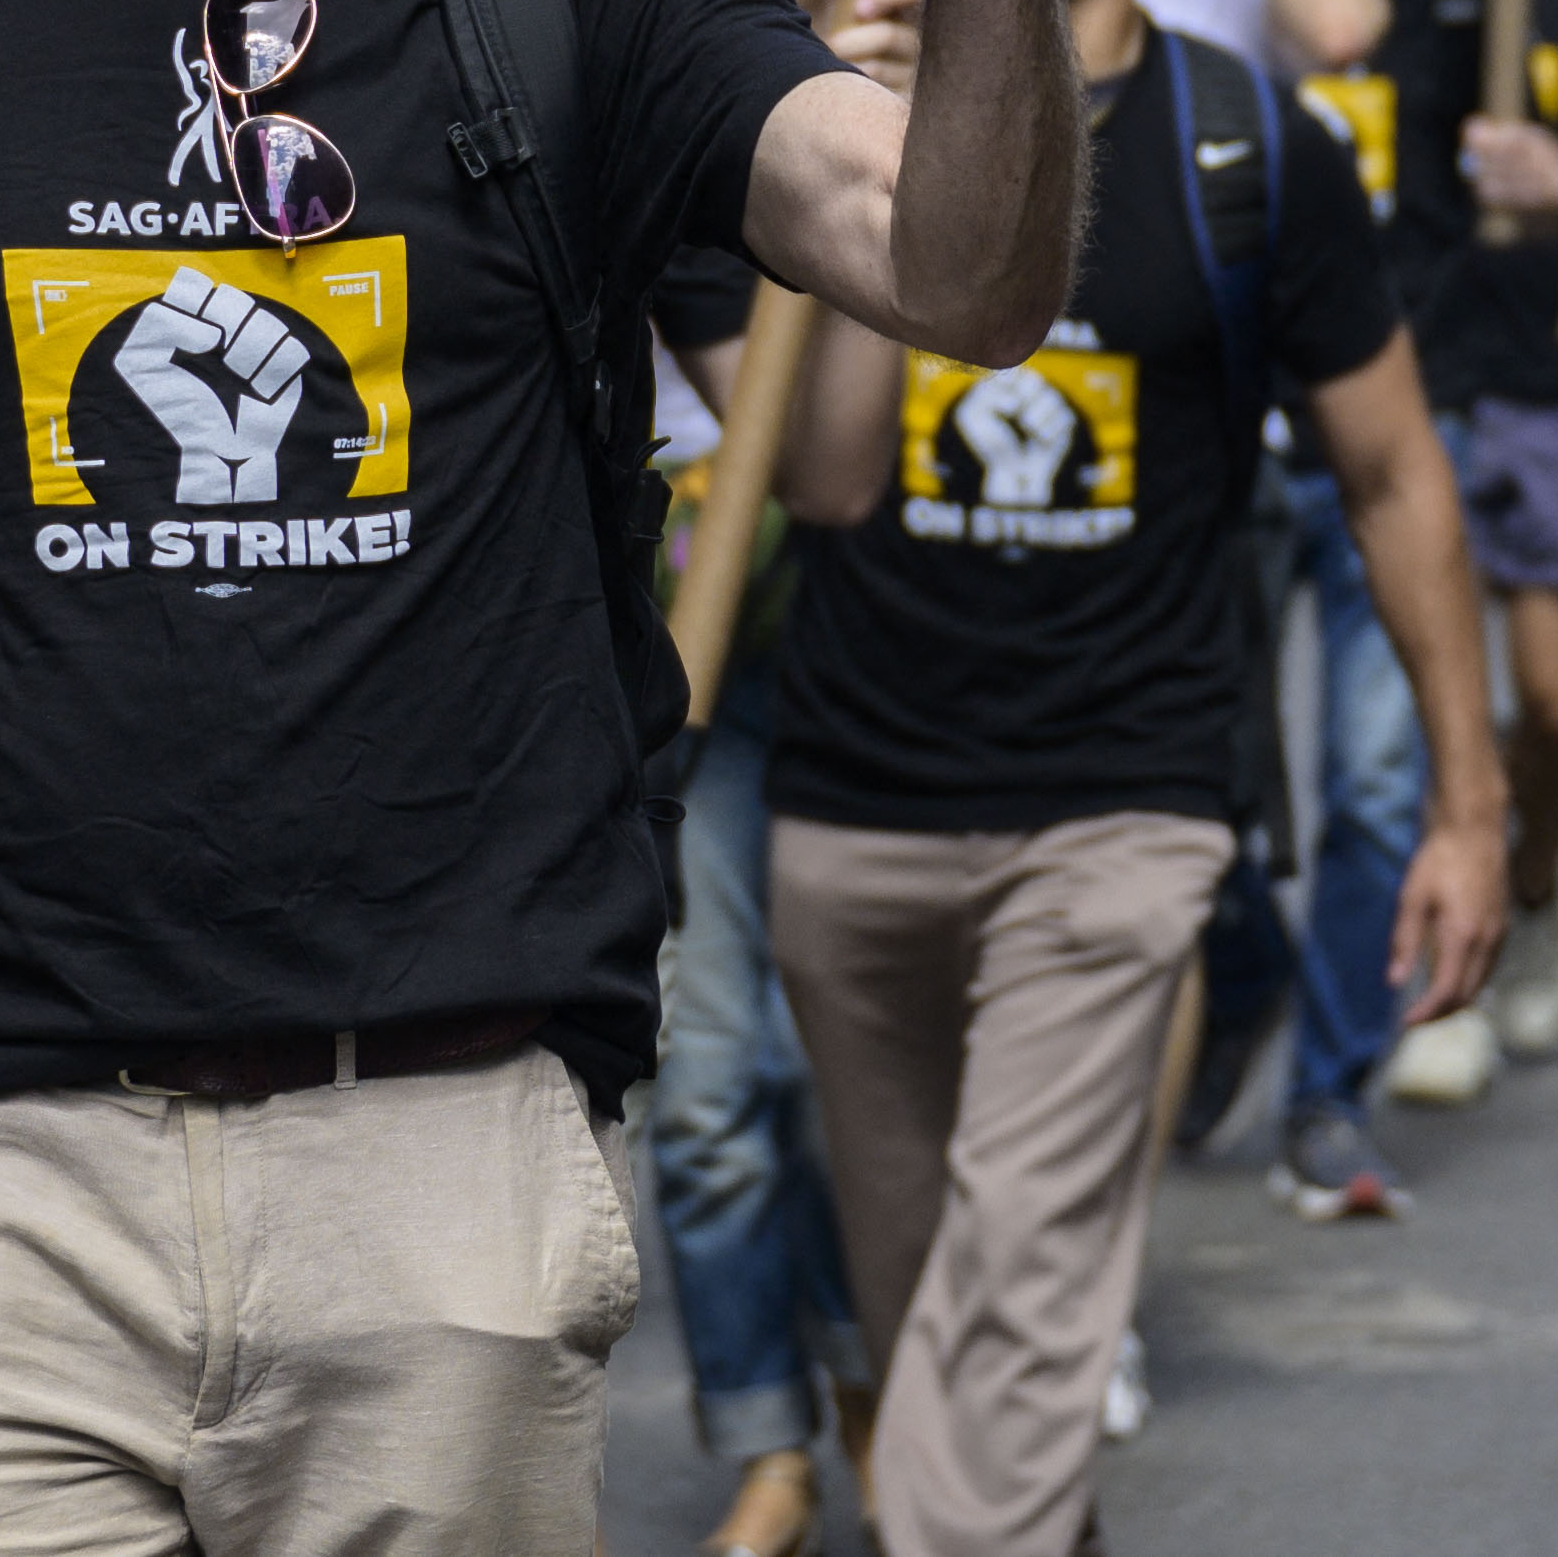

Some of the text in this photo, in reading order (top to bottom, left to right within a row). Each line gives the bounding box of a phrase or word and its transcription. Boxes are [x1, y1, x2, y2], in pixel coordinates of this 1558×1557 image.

[329, 282, 369, 297] PAUSE
[34, 510, 412, 572] ON STRIKE!
